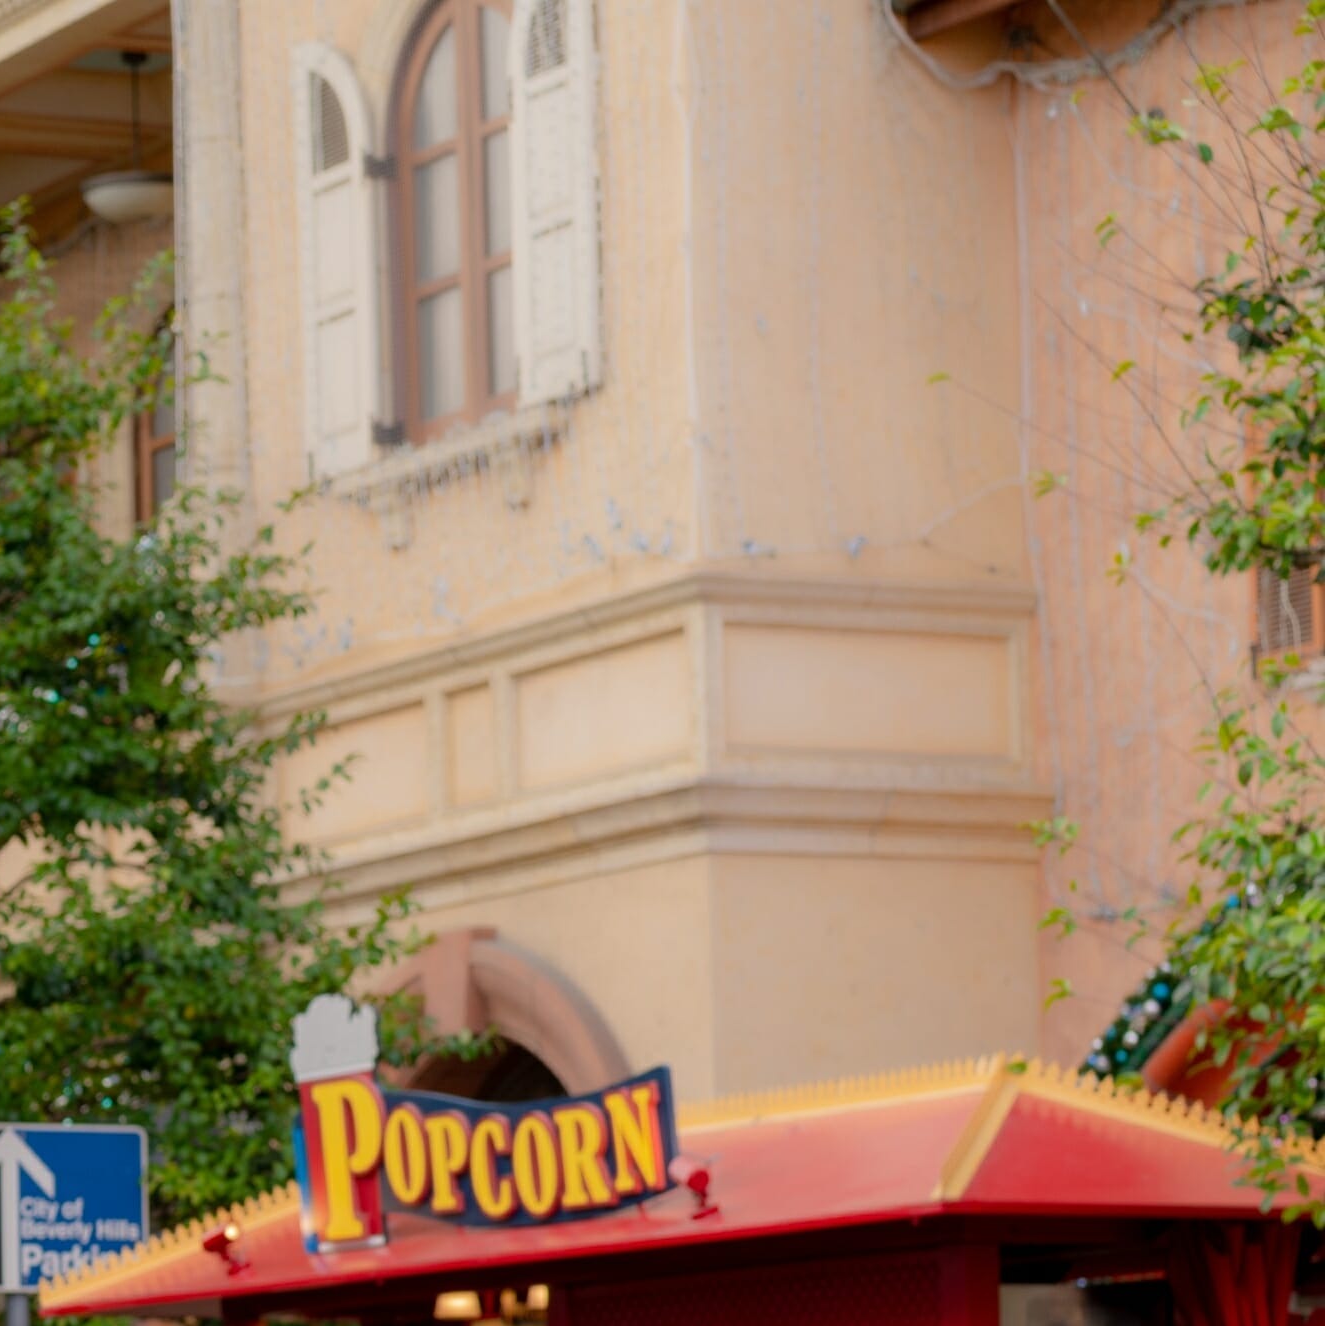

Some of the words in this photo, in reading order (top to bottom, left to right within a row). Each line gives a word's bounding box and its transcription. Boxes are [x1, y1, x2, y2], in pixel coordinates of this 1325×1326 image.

[311, 1078, 663, 1240] POPCORN
[20, 1196, 58, 1222] City
[61, 1197, 84, 1219] of
[20, 1218, 93, 1244] Beverly
[96, 1218, 139, 1241] Hills
